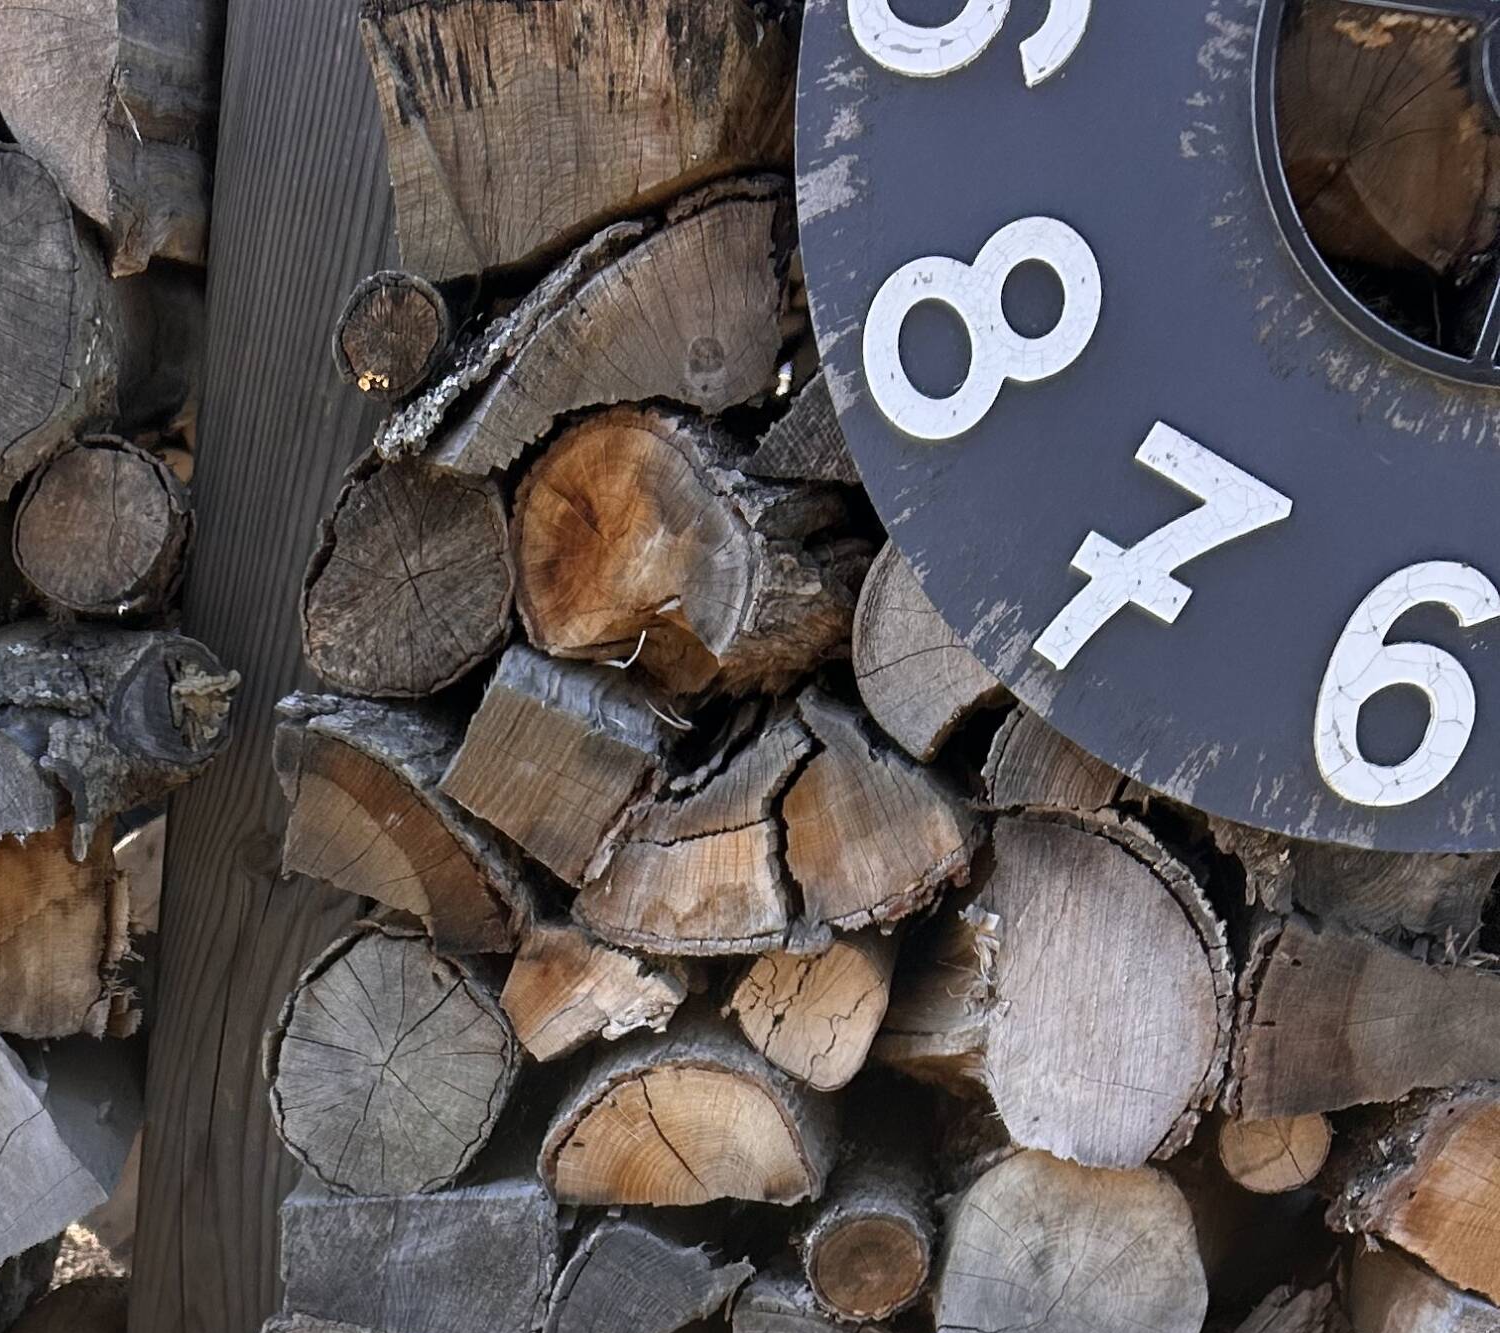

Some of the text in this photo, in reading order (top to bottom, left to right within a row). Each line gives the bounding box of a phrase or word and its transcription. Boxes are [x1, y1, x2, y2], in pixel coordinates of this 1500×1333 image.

[863, 216, 1101, 440] 8
[1033, 420, 1293, 671] 7
[1314, 560, 1500, 806] 6
